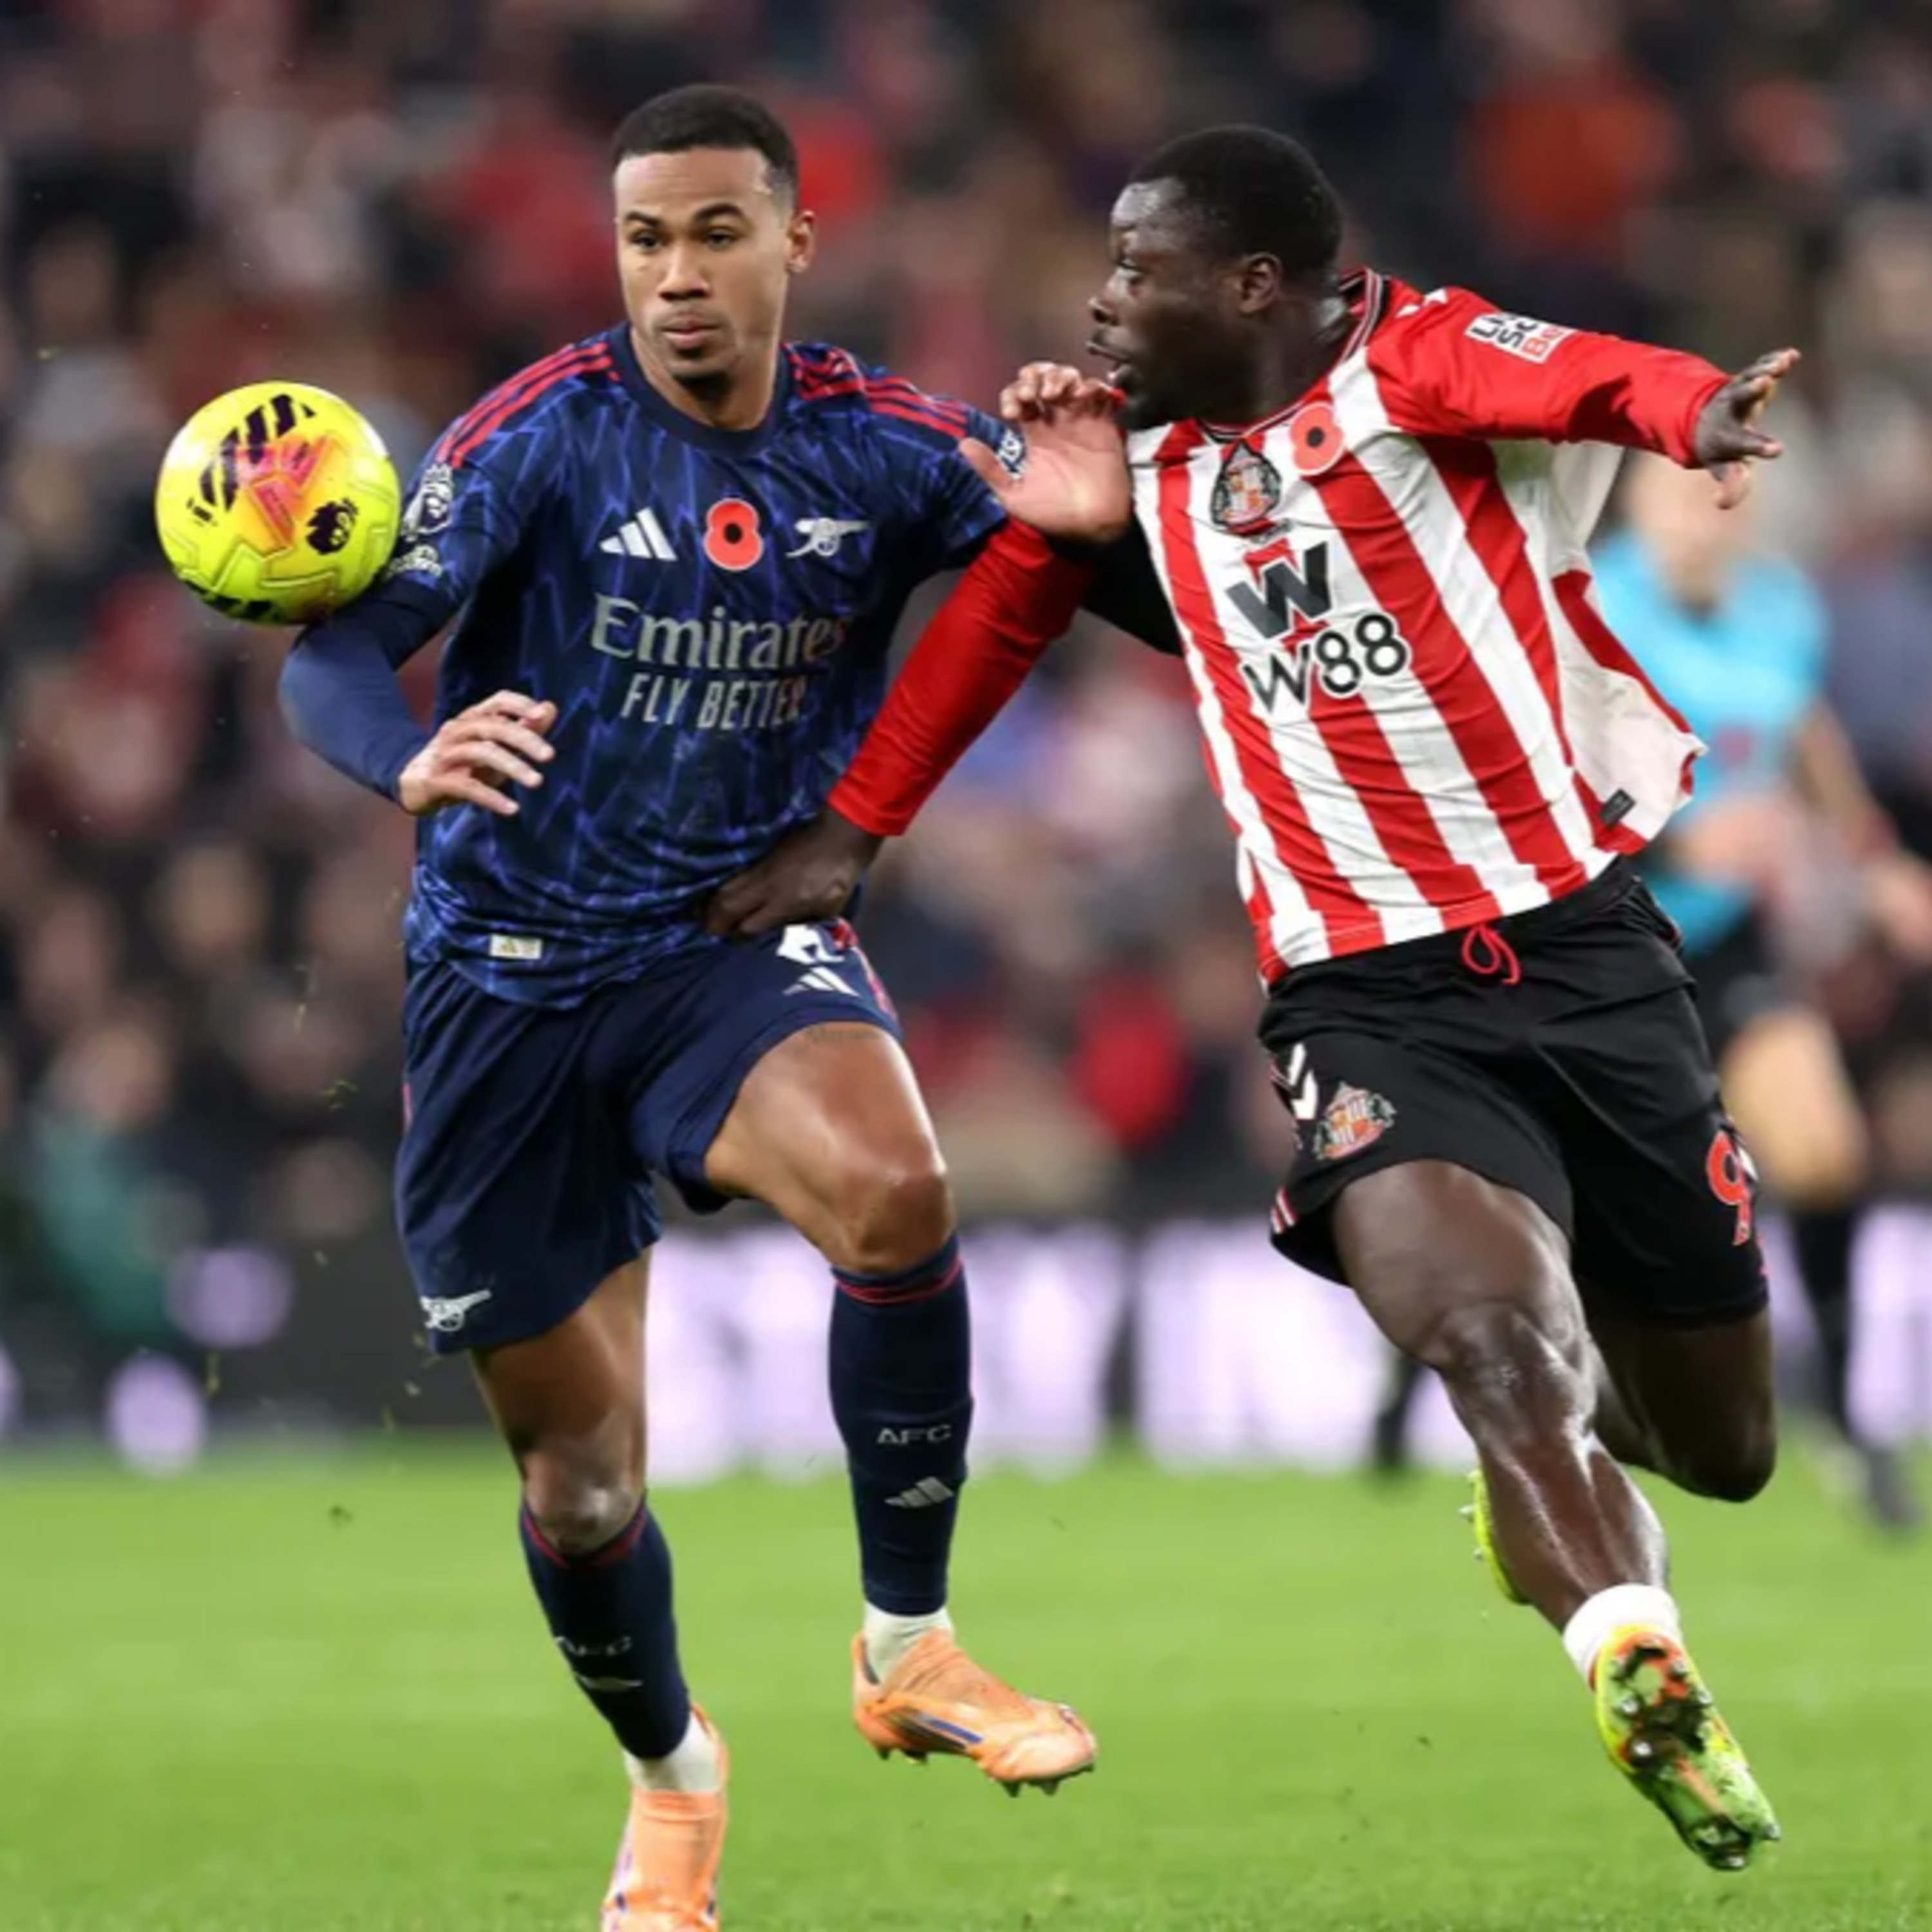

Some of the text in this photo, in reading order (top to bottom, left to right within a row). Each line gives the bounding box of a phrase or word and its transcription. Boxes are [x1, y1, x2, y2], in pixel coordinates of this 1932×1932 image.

[621, 673, 692, 726] FLY
[1242, 614, 1408, 713] W88
[1707, 1131, 1752, 1246] 9
[876, 1425, 952, 1444] AFC
